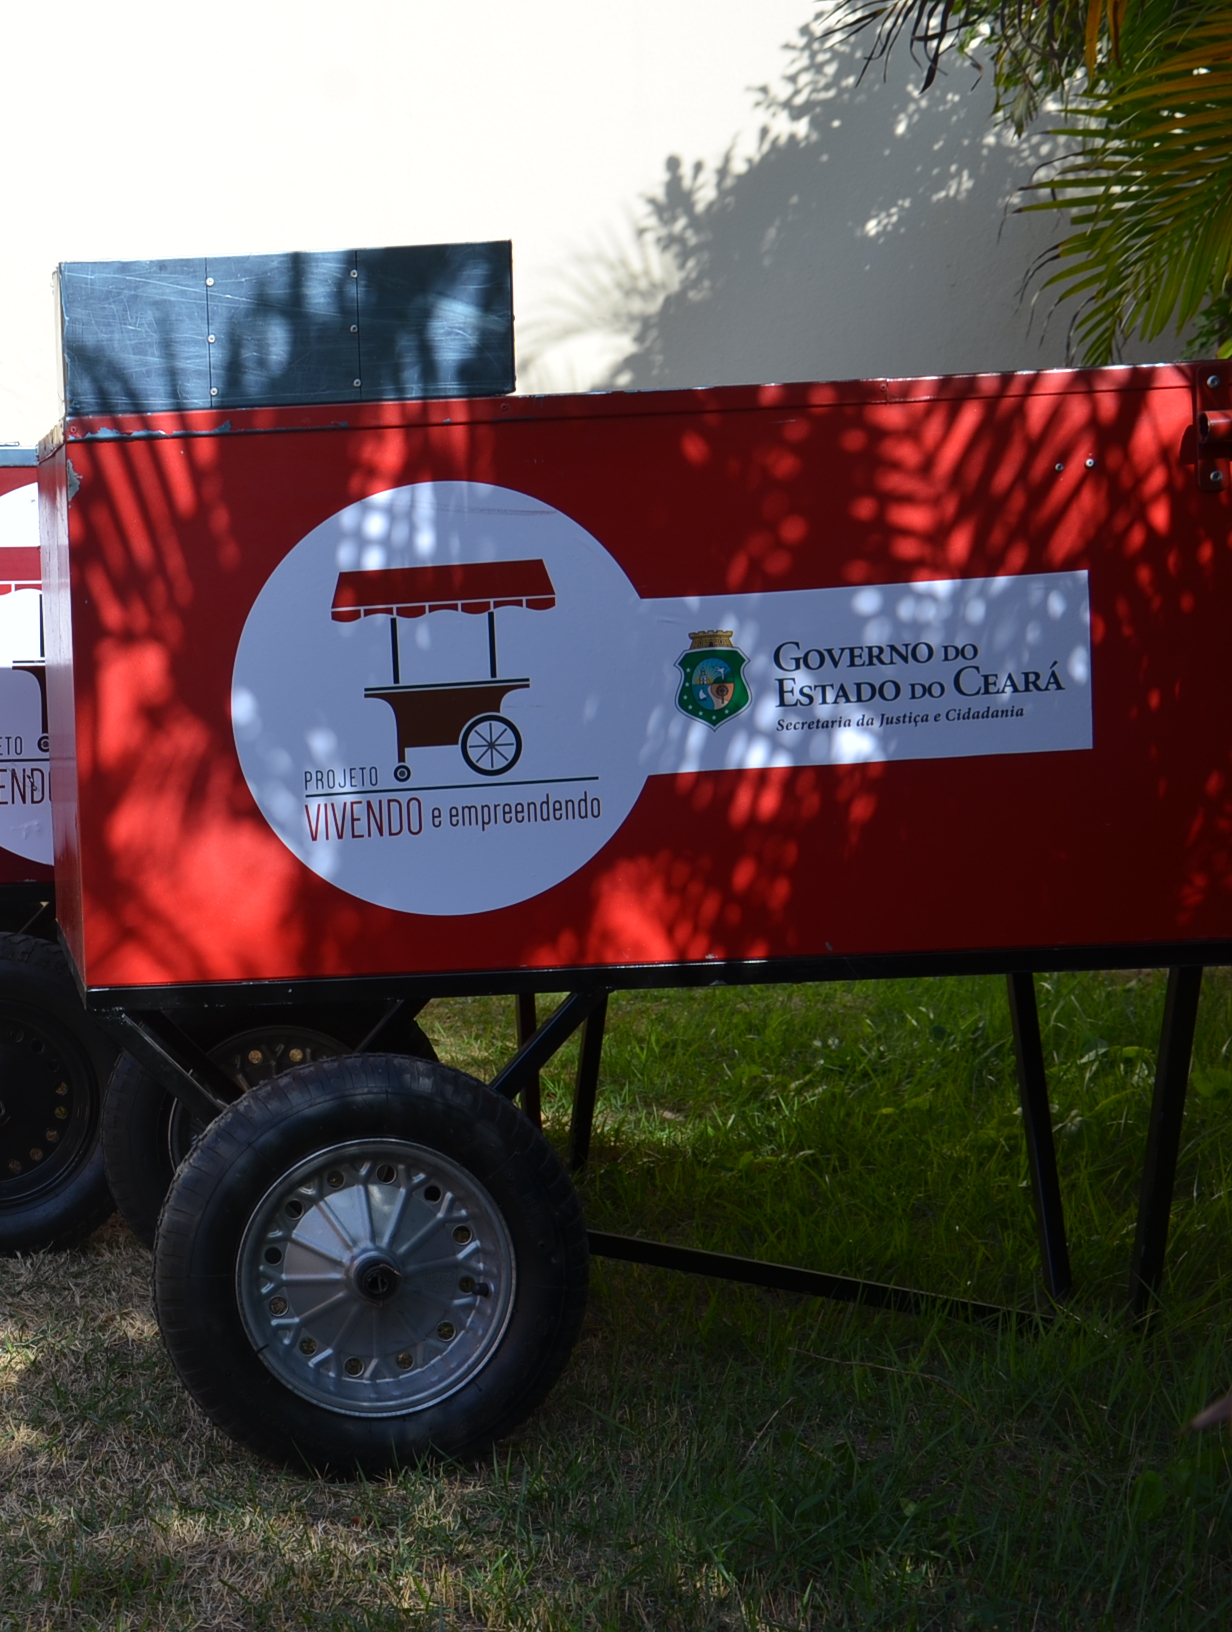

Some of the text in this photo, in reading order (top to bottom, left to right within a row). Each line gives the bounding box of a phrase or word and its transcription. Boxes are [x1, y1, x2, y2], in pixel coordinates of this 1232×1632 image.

[773, 641, 934, 672] GOVERNO
[774, 677, 902, 708] ESTADO
[776, 705, 1024, 732] Secretaria da Justiça e Cidadania
[304, 766, 378, 791] PROJETO
[305, 791, 601, 842] VIVENDO e empreendendo
